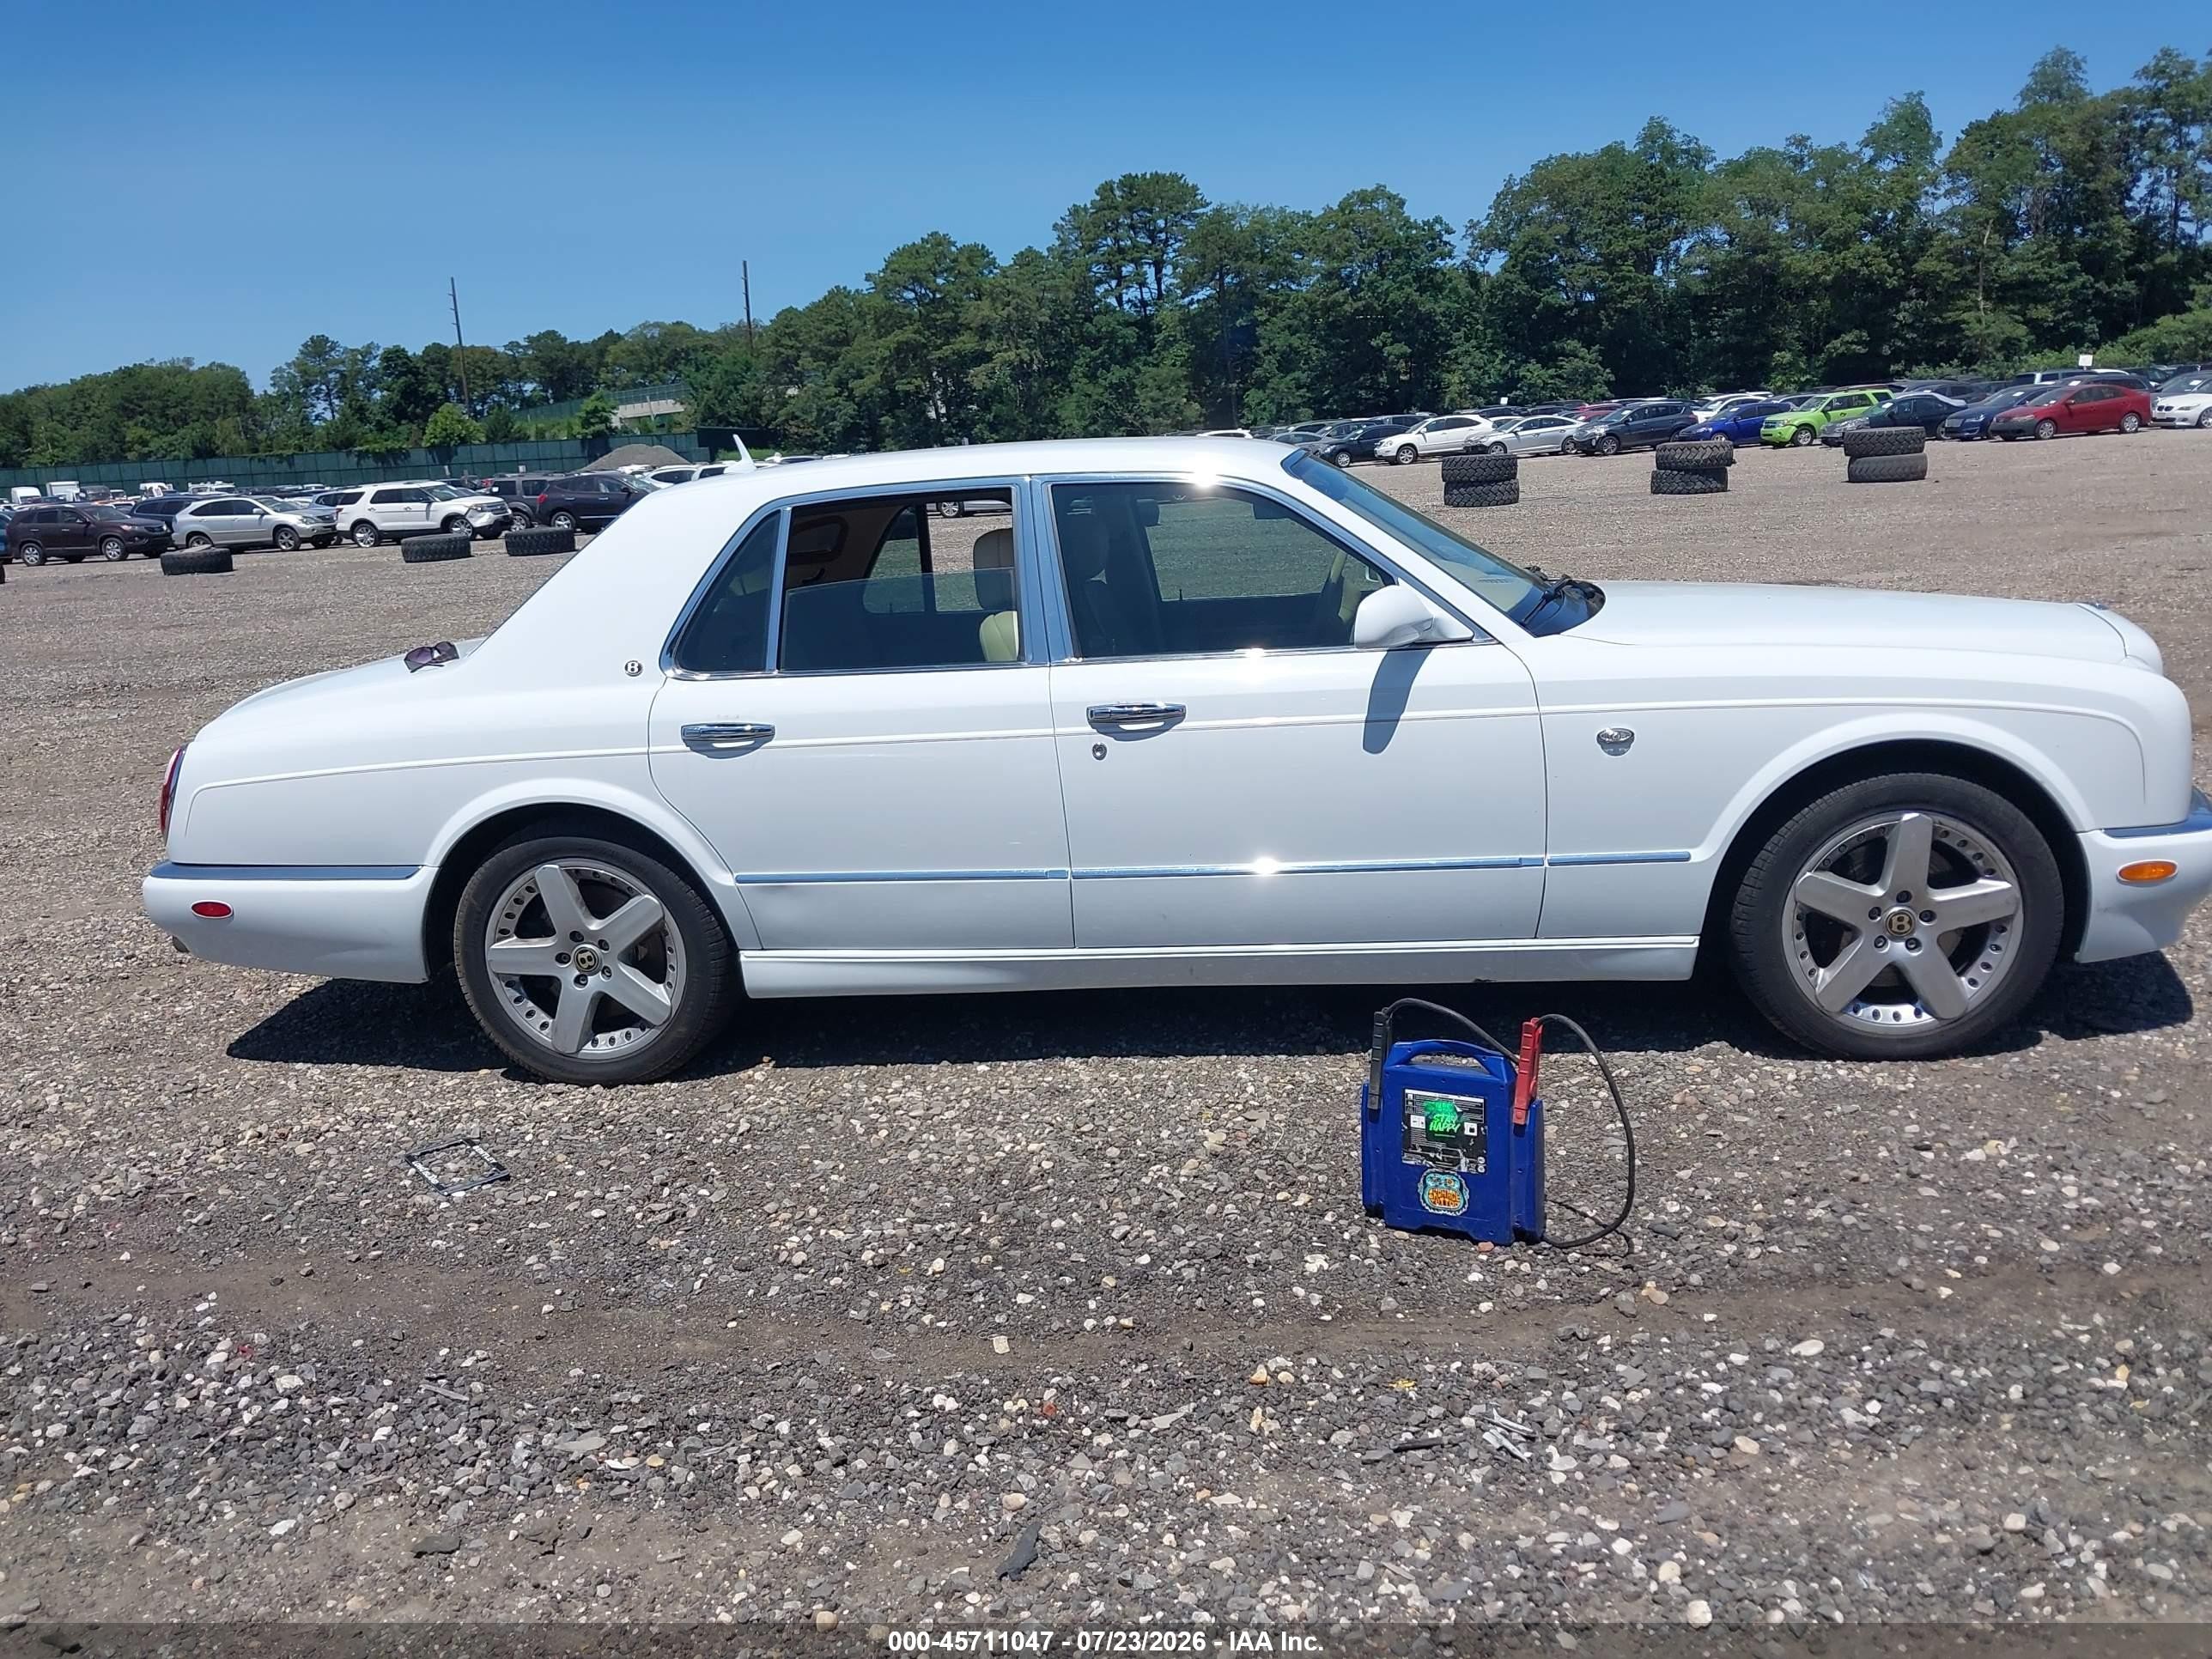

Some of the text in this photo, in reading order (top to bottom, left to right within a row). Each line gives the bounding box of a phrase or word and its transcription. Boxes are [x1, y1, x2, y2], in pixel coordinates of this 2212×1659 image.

[1891, 913, 1911, 933] B
[577, 951, 595, 969] B
[1429, 1121, 1462, 1133] HAPPY
[472, 1145, 497, 1164] BENTLEY
